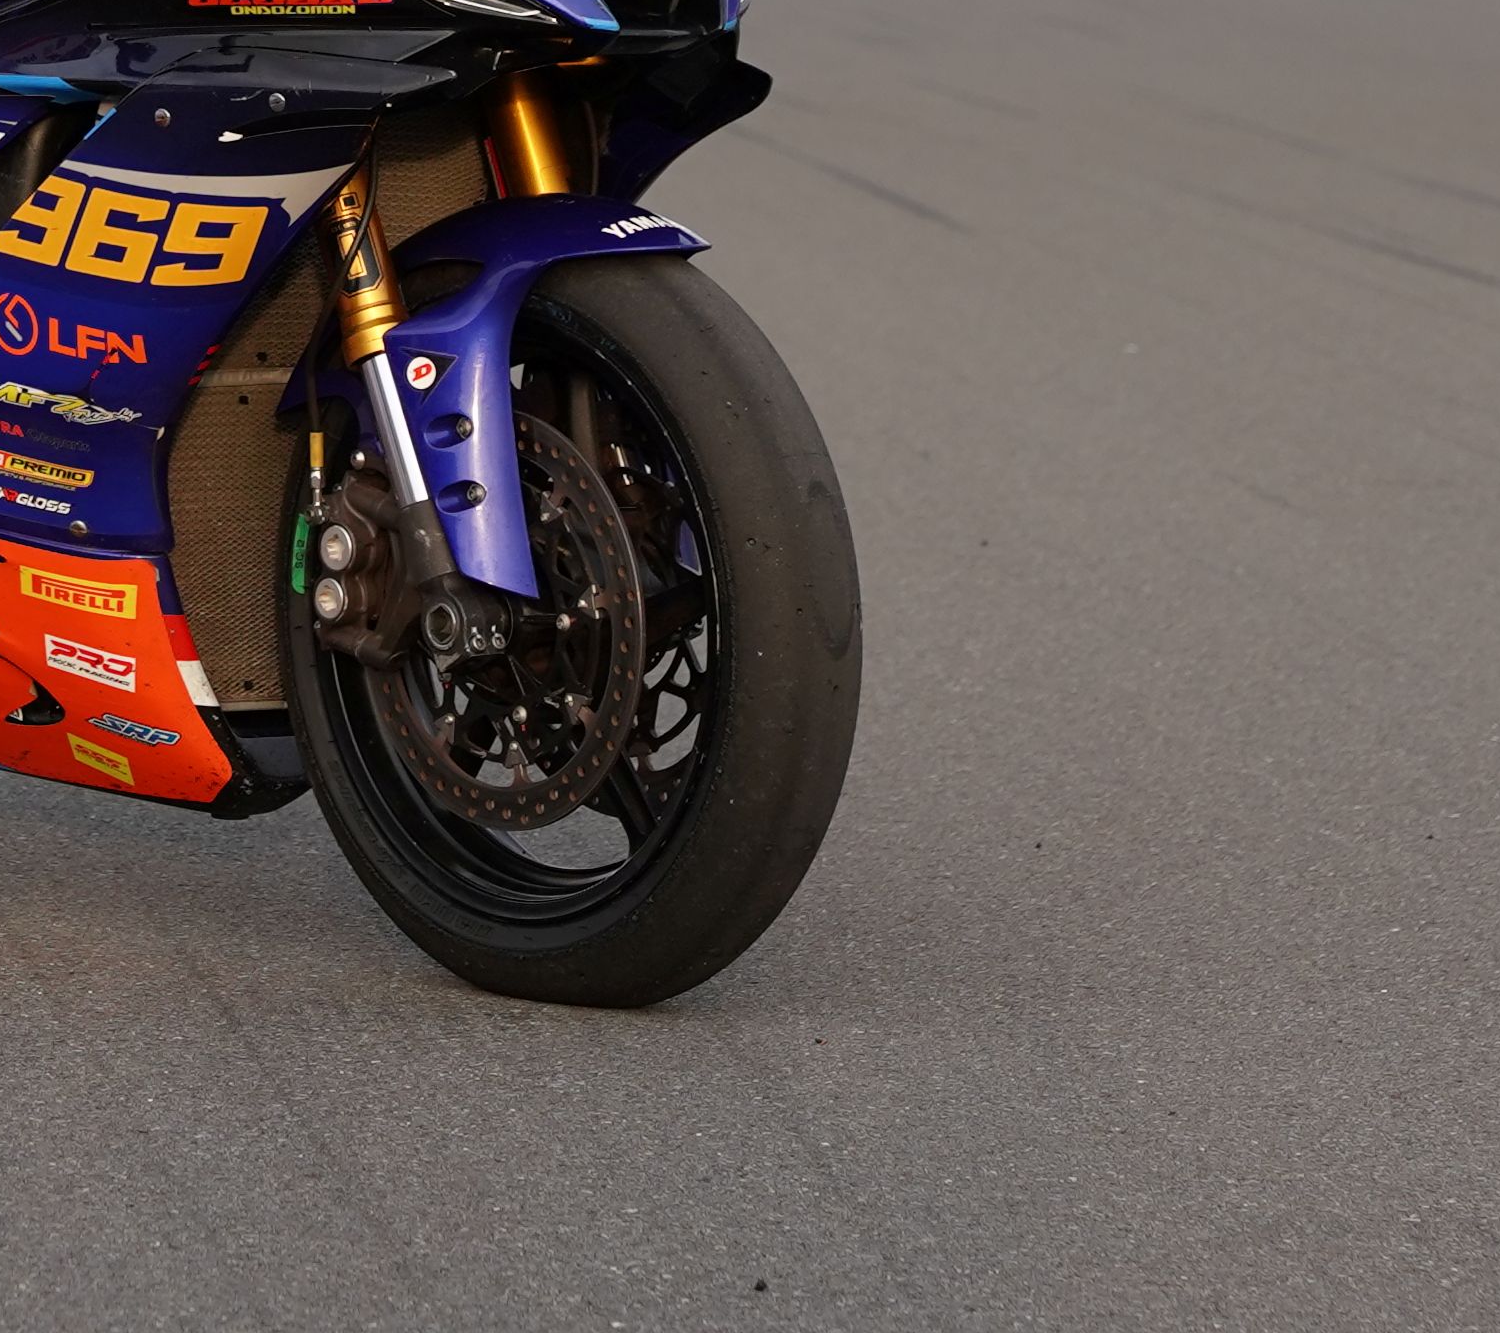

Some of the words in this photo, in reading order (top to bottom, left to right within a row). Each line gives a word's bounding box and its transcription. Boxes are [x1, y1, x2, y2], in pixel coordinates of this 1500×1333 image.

[230, 5, 356, 16] ONDOLOMON
[48, 317, 148, 365] LFN
[10, 457, 87, 483] PREMIO
[31, 573, 127, 613] PIRELLI
[88, 713, 181, 745] SRP
